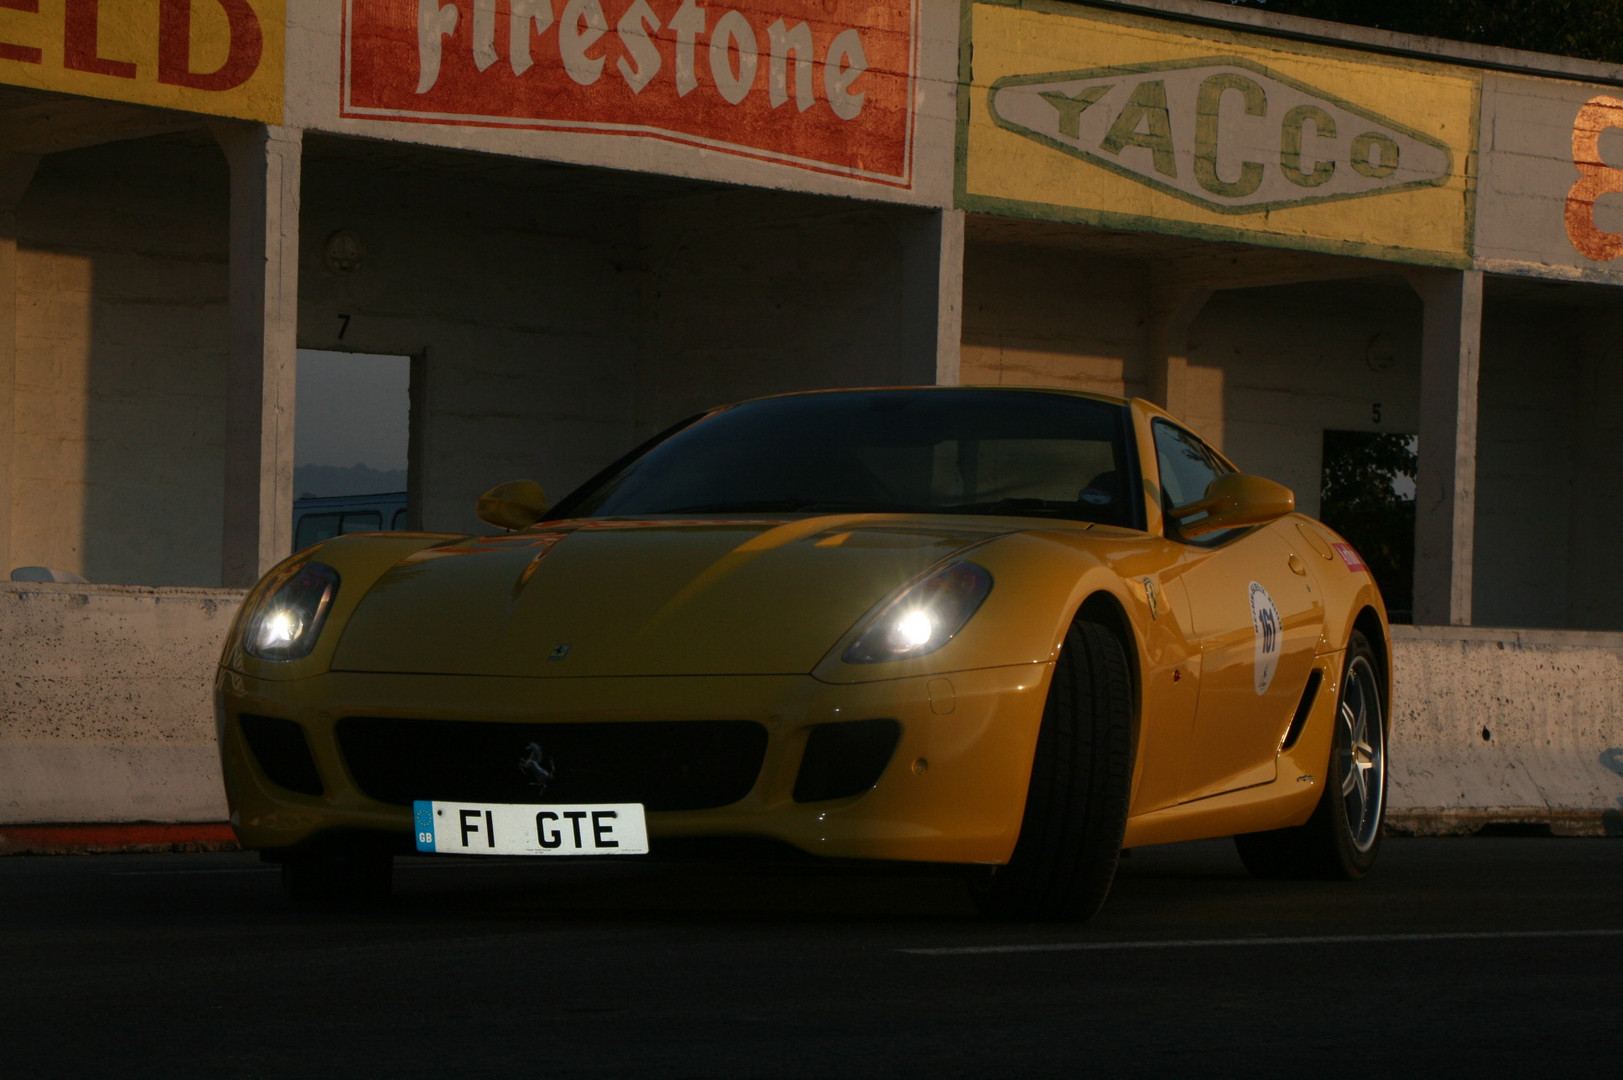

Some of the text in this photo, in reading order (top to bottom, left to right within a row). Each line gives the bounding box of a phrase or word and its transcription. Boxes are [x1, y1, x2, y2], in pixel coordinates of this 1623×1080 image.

[338, 313, 350, 339] 7
[1373, 404, 1381, 423] 5
[418, 832, 433, 844] GB
[536, 811, 619, 848] GTE
